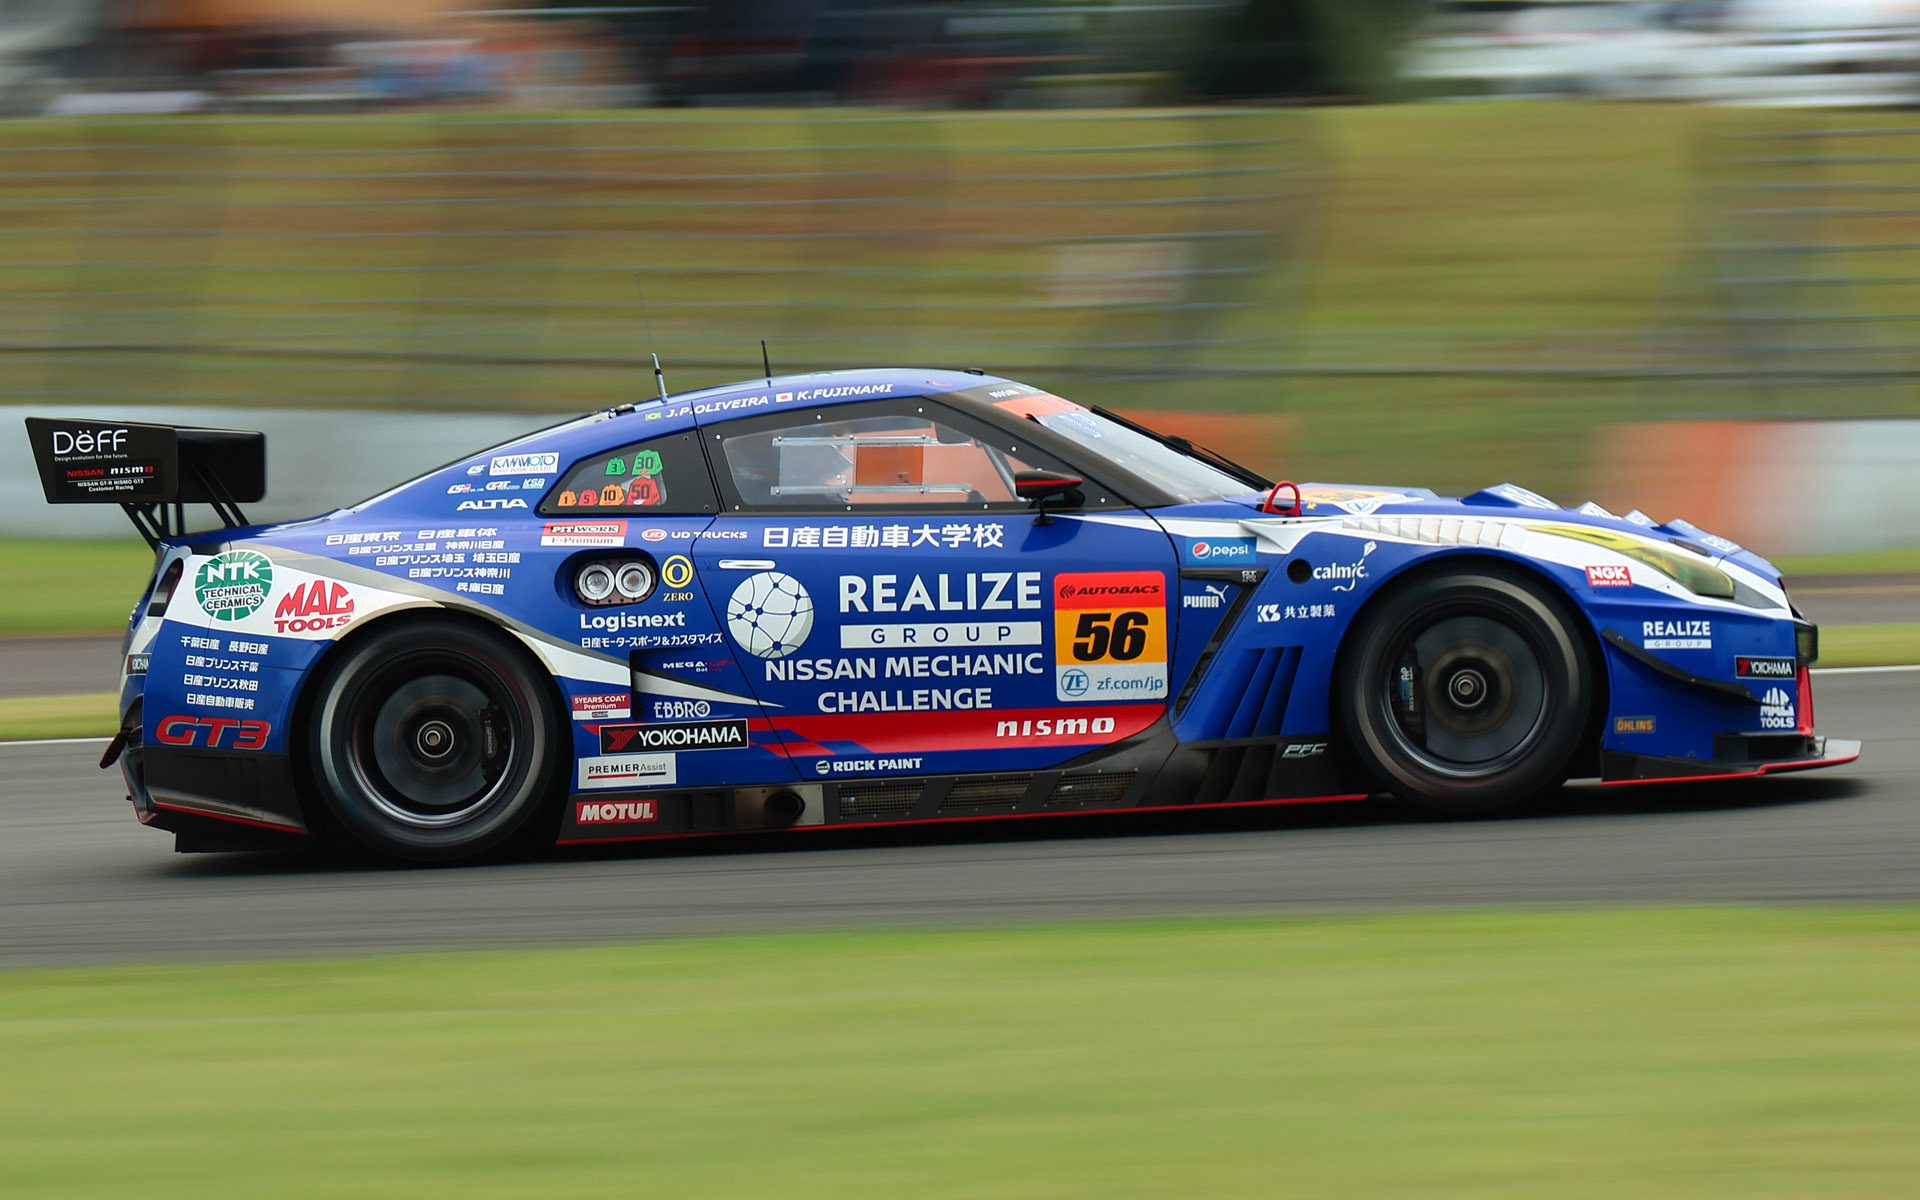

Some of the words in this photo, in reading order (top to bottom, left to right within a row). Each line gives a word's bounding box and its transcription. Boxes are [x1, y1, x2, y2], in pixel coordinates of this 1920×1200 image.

[665, 396, 769, 418] J.P.OLIVEIRA
[797, 383, 893, 400] K.FUJINAMI
[67, 469, 104, 477] NISSAN
[110, 465, 154, 475] nismo
[636, 457, 653, 470] 30
[603, 490, 616, 501] 10
[631, 484, 650, 499] 50
[326, 531, 402, 546] 日産東京
[417, 527, 498, 540] 日産車体
[671, 531, 691, 539] UD
[694, 531, 748, 539] TRUCKS
[763, 523, 1003, 548] 日産自動車大学校
[445, 540, 504, 550] 神奈川日産
[1212, 544, 1249, 557] pepsi
[472, 552, 521, 564] 埼玉日産
[206, 560, 261, 583] NTK
[1588, 567, 1628, 579] NGK
[203, 583, 262, 599] TECHNICAL
[456, 582, 505, 595] 兵庫日産
[838, 571, 1042, 613] REALIZE
[1076, 585, 1160, 596] AUTOBACS
[205, 595, 261, 611] CERAMICS
[274, 580, 355, 618] MAC
[663, 592, 694, 602] ZERO
[1183, 595, 1219, 608] PUMA
[1285, 604, 1336, 619] 共立製薬
[273, 614, 353, 634] TOOLS
[580, 611, 686, 633] Logisnext
[1643, 621, 1711, 636] REALIZE
[870, 625, 1012, 644] GROUP
[1072, 611, 1149, 661] 56
[181, 636, 221, 650] 千葉日産
[228, 641, 269, 655] 長野日産
[185, 655, 260, 673] 日産プリンス千葉
[765, 659, 877, 681] NISSAN
[885, 653, 1044, 678] MECHANIC
[1750, 661, 1793, 674] YOKOHAMA
[183, 674, 259, 691] 日産プリンス秋田
[1097, 676, 1163, 691] zf.com/jp
[186, 694, 255, 710] 日産自動車販売
[574, 696, 603, 704] 5YEARS
[604, 695, 626, 703] COAT
[817, 687, 993, 713] CHALLENGE
[996, 717, 1115, 737] nismo
[1760, 717, 1795, 728] TOOLS
[155, 715, 271, 750] GT3
[638, 726, 742, 746] YOKOHAMA
[833, 761, 875, 772] ROCK
[878, 758, 922, 770] PAINT
[580, 802, 654, 821] MOTUL
